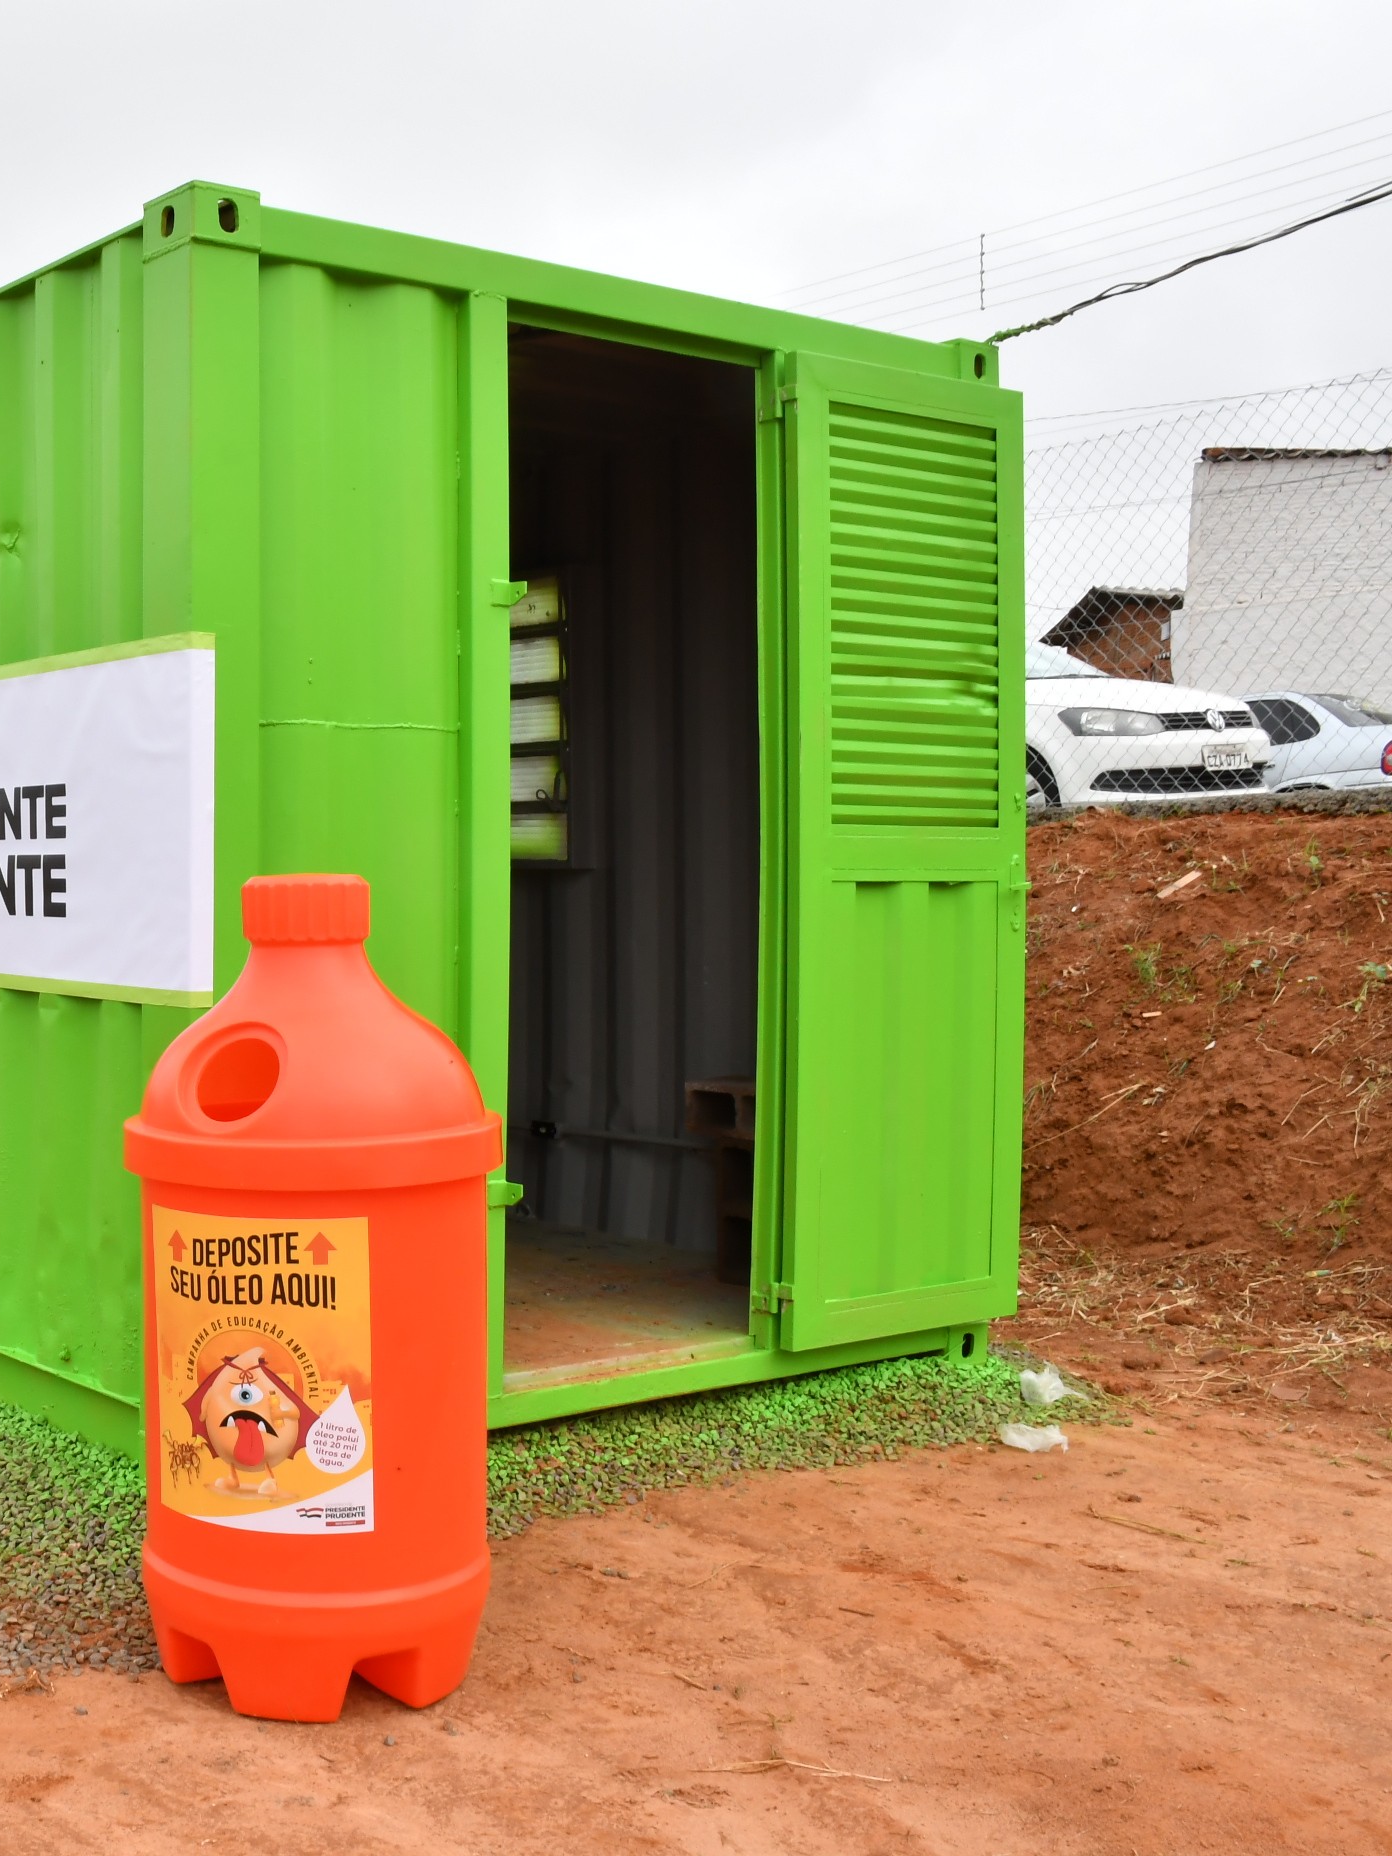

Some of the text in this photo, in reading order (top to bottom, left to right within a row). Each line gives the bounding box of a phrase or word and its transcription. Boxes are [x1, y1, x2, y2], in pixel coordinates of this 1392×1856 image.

[192, 1231, 300, 1267] DEPOSITE
[170, 1265, 337, 1310] SEU ÓLEO AQUI!
[187, 1316, 319, 1399] CAMPANHA DE EDUCAÇÃO AMBIENTAL
[325, 1422, 344, 1432] litro
[314, 1430, 334, 1439] óleo
[316, 1447, 338, 1457] litros
[343, 1444, 358, 1452] mil
[325, 1505, 366, 1513] PRESIDENTE
[325, 1511, 366, 1519] PRUDENTE
